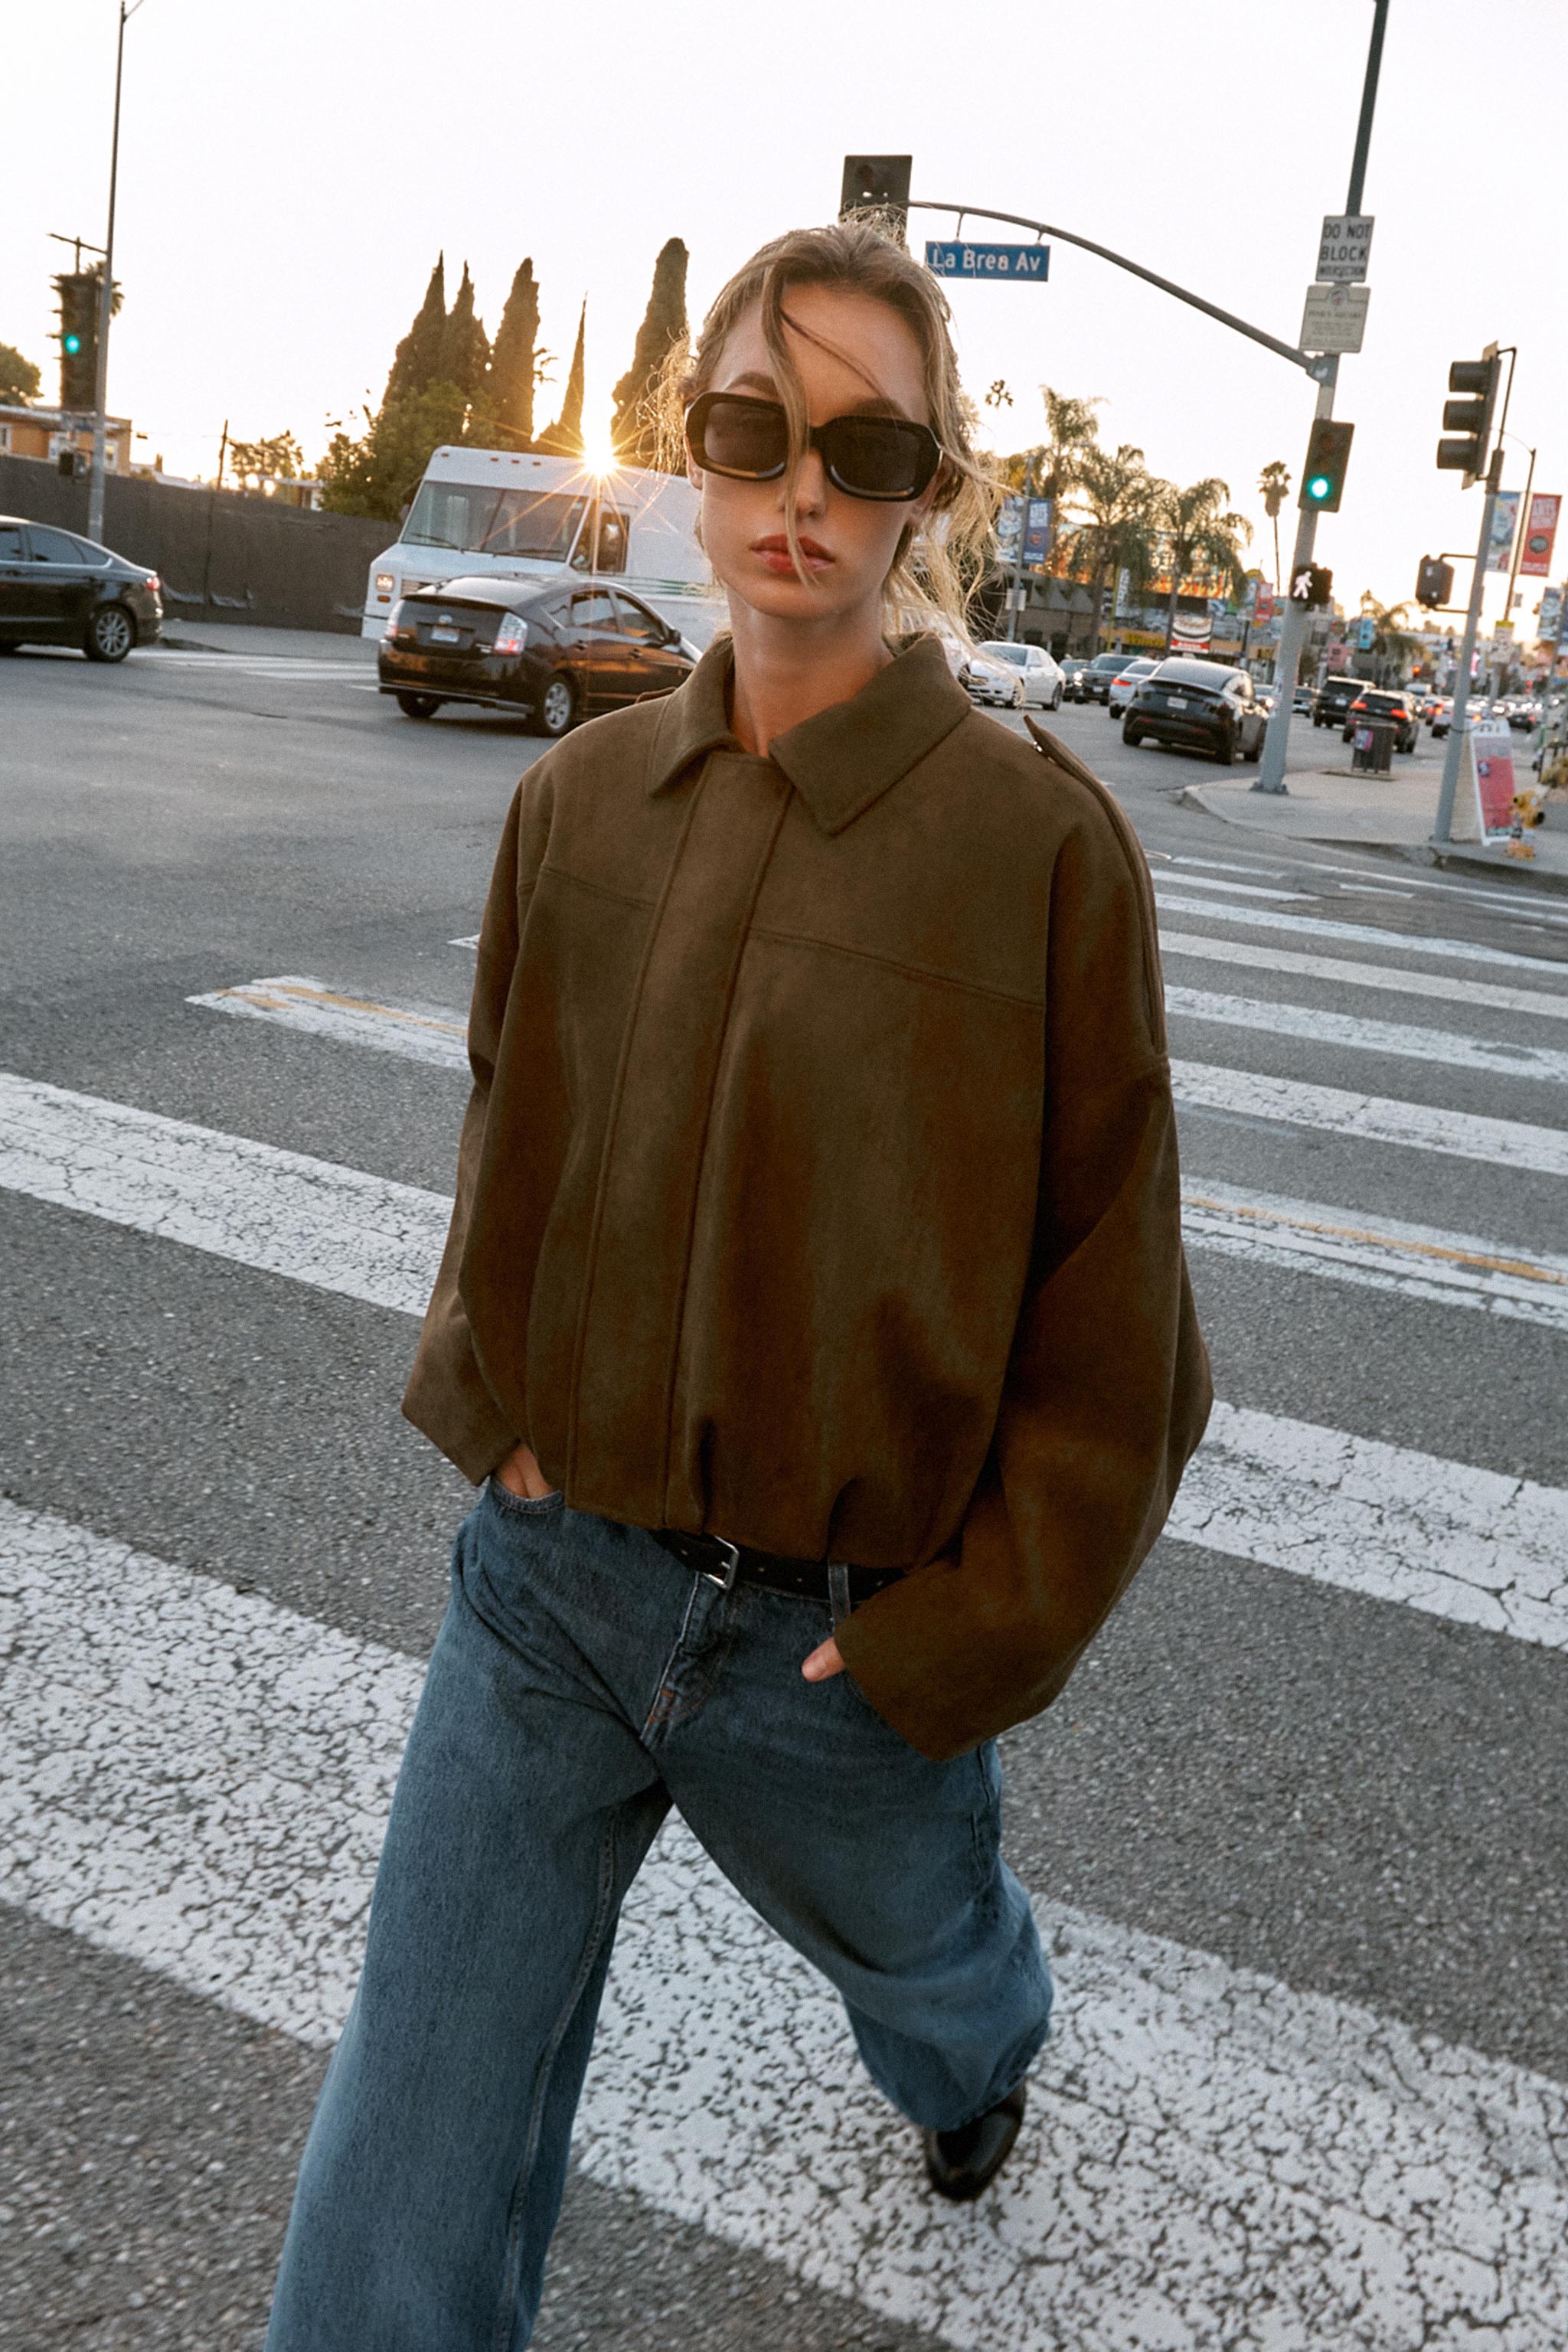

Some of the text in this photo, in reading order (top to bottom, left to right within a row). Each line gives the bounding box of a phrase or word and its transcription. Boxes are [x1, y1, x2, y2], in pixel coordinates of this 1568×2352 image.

[1323, 224, 1371, 239] DO NOT
[933, 249, 1040, 271] La Brea Av
[1320, 246, 1367, 260] BLOCK
